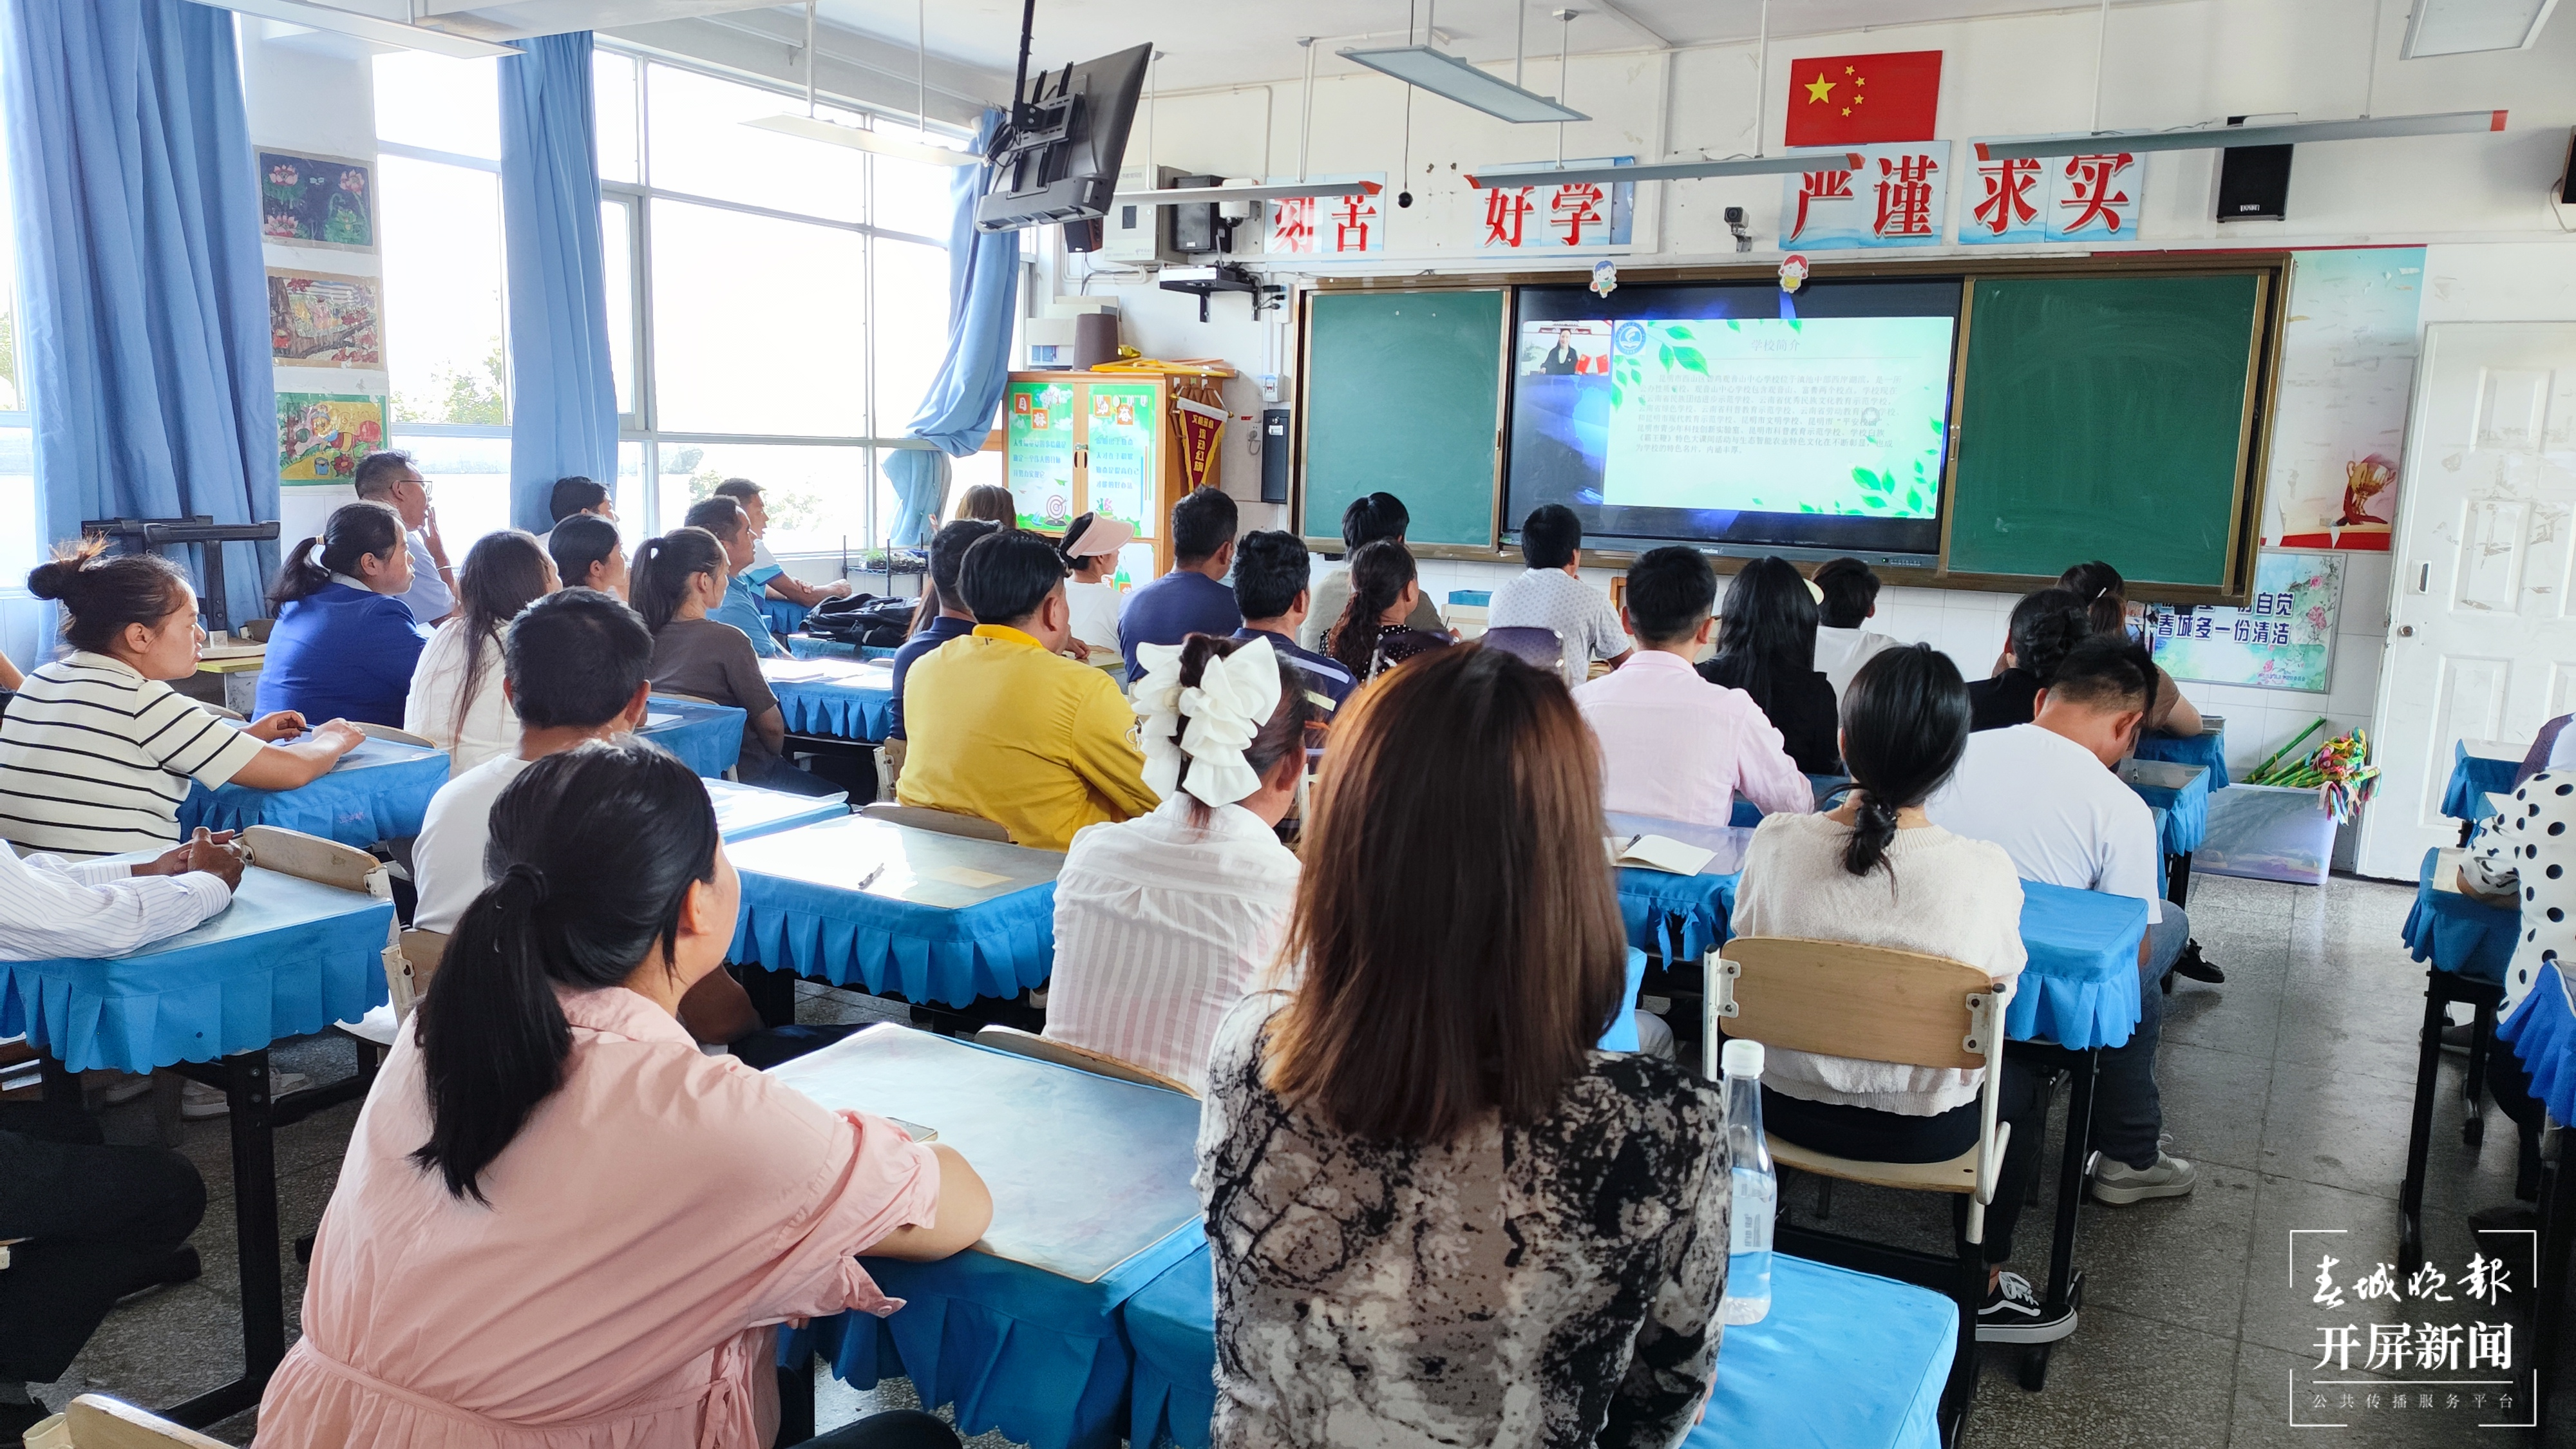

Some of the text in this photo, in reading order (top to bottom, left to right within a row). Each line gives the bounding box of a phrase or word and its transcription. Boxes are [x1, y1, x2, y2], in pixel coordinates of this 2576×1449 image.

[1273, 153, 2134, 253] 刻苦 好学 严谨 求实
[1751, 338, 1801, 352] 学校简介
[2157, 614, 2291, 646] 春城多一份清洁
